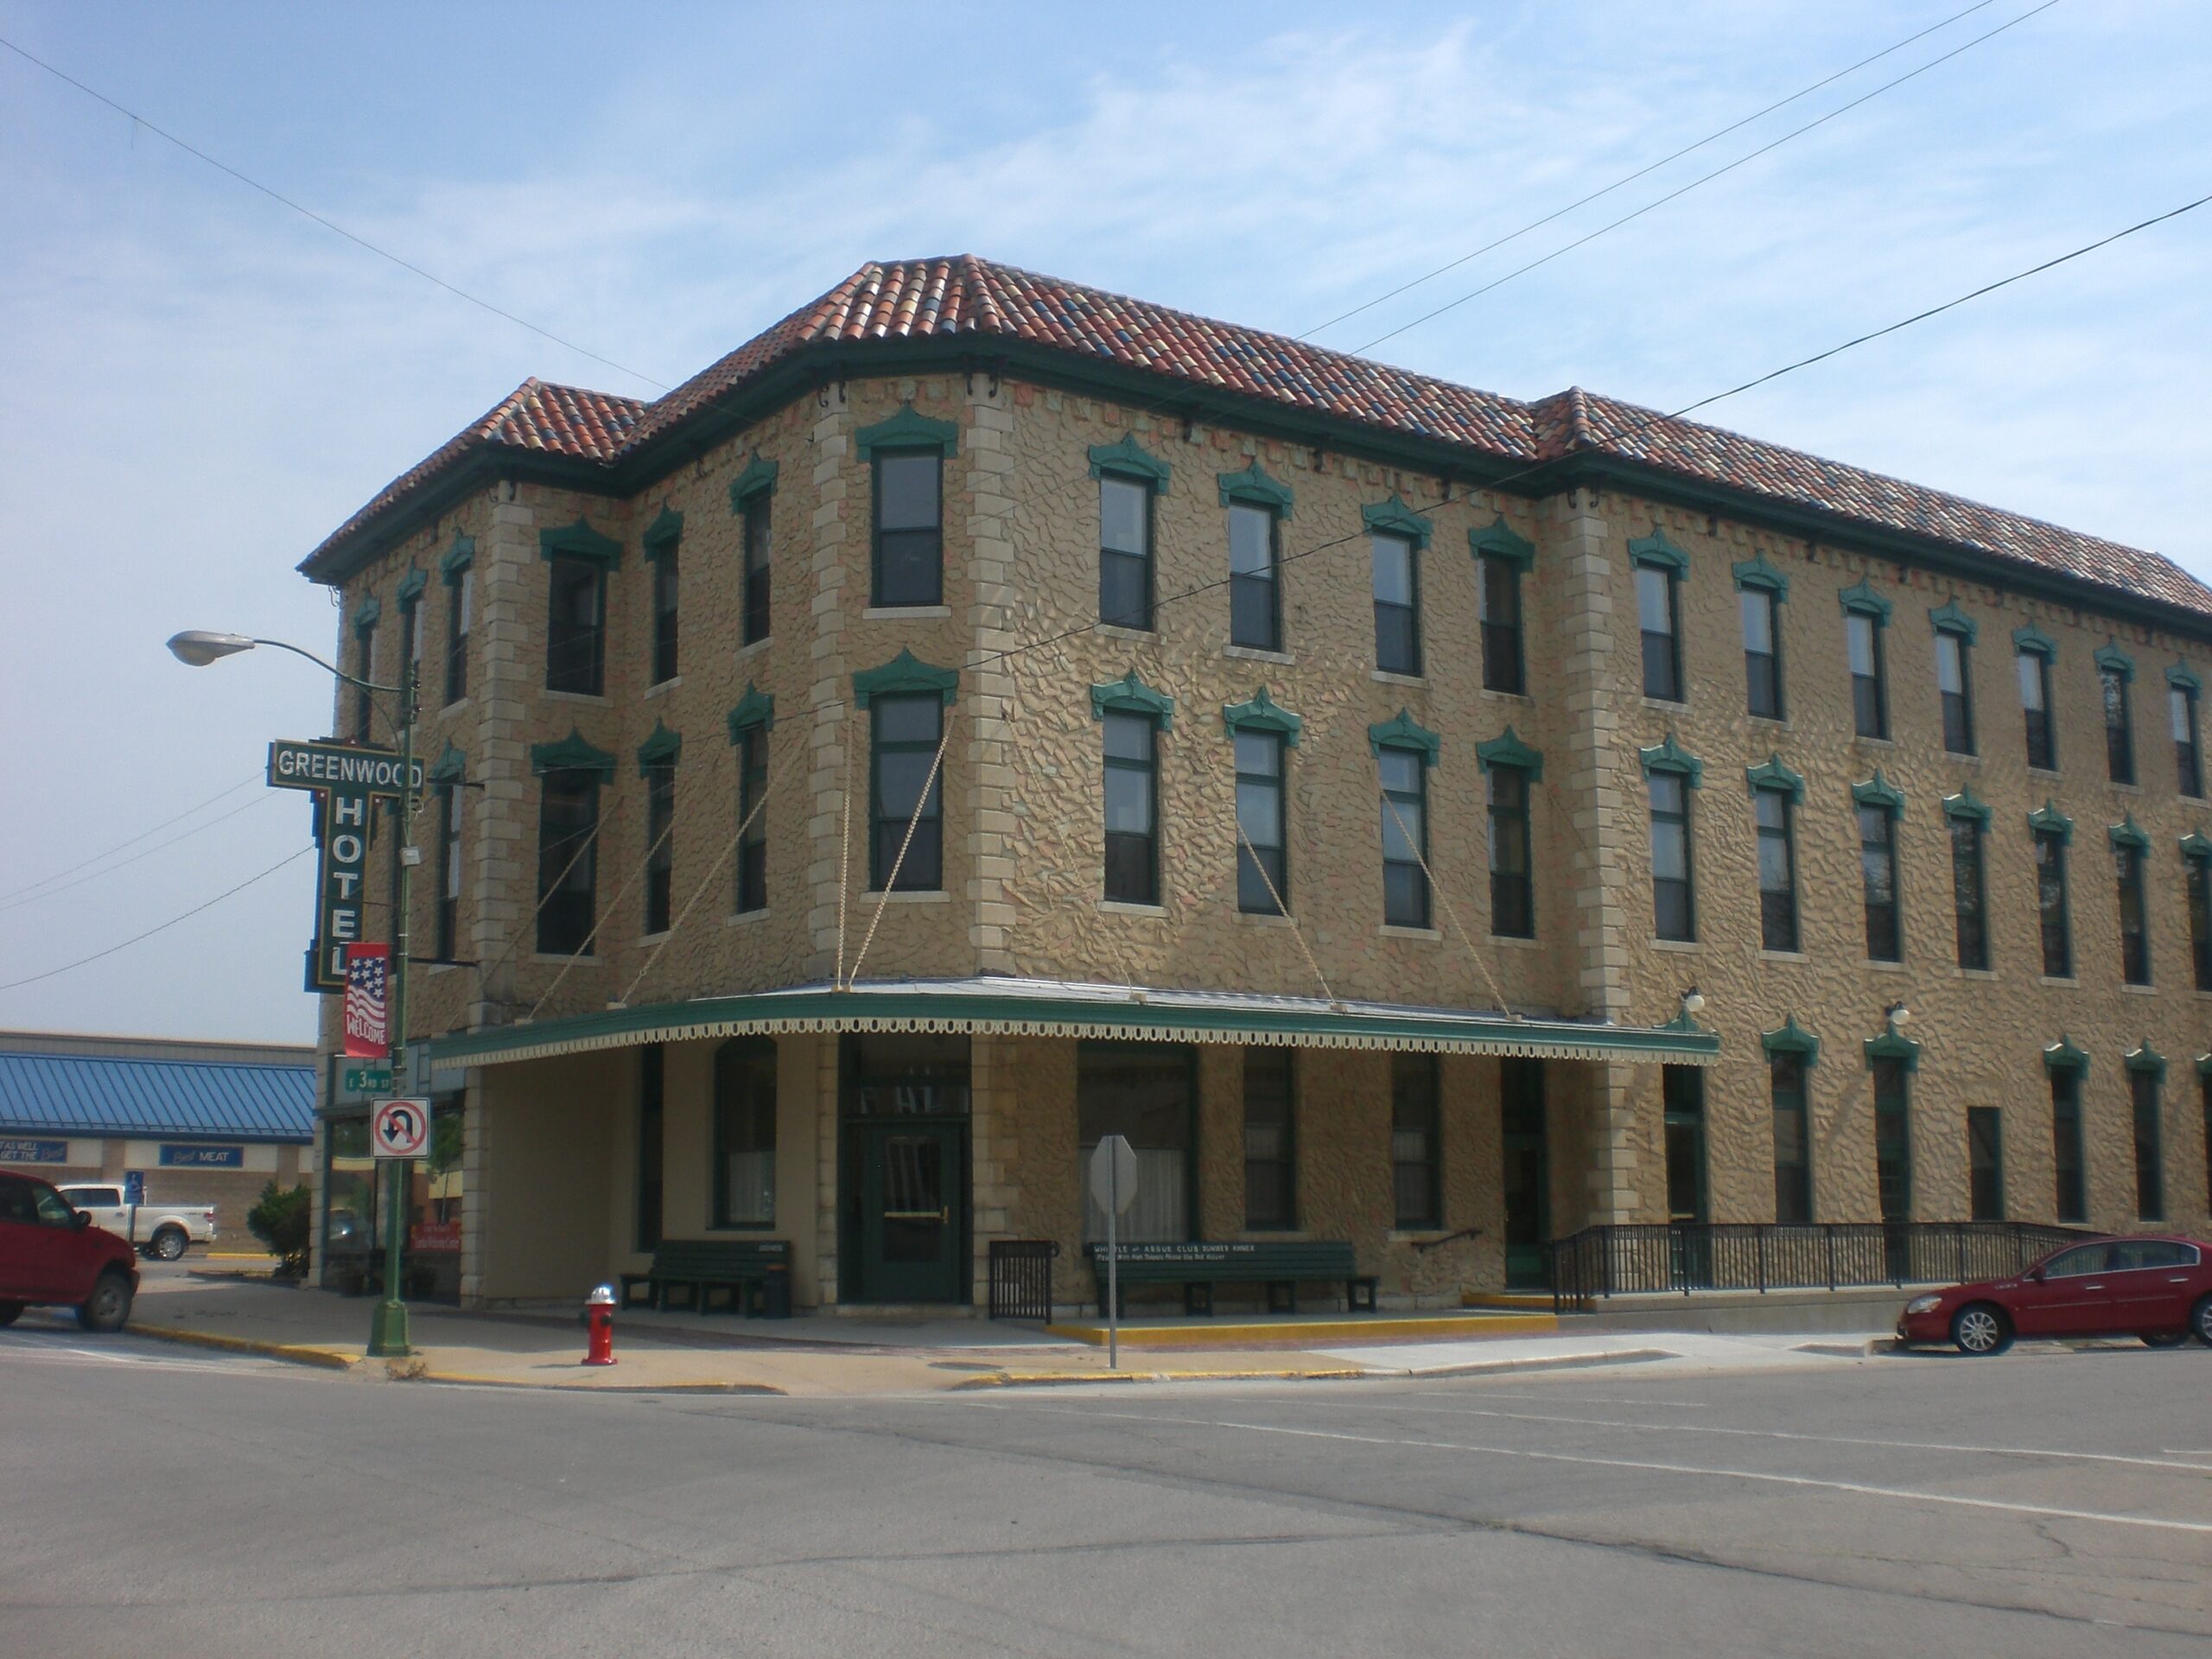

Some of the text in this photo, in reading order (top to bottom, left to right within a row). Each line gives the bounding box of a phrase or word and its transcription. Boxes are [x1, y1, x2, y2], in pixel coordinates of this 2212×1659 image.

[278, 749, 423, 788] GREENWOOD
[331, 797, 363, 976] HOTEL
[346, 1014, 386, 1046] WELCOME
[20, 1151, 37, 1160] THE
[199, 1152, 229, 1162] MEAT
